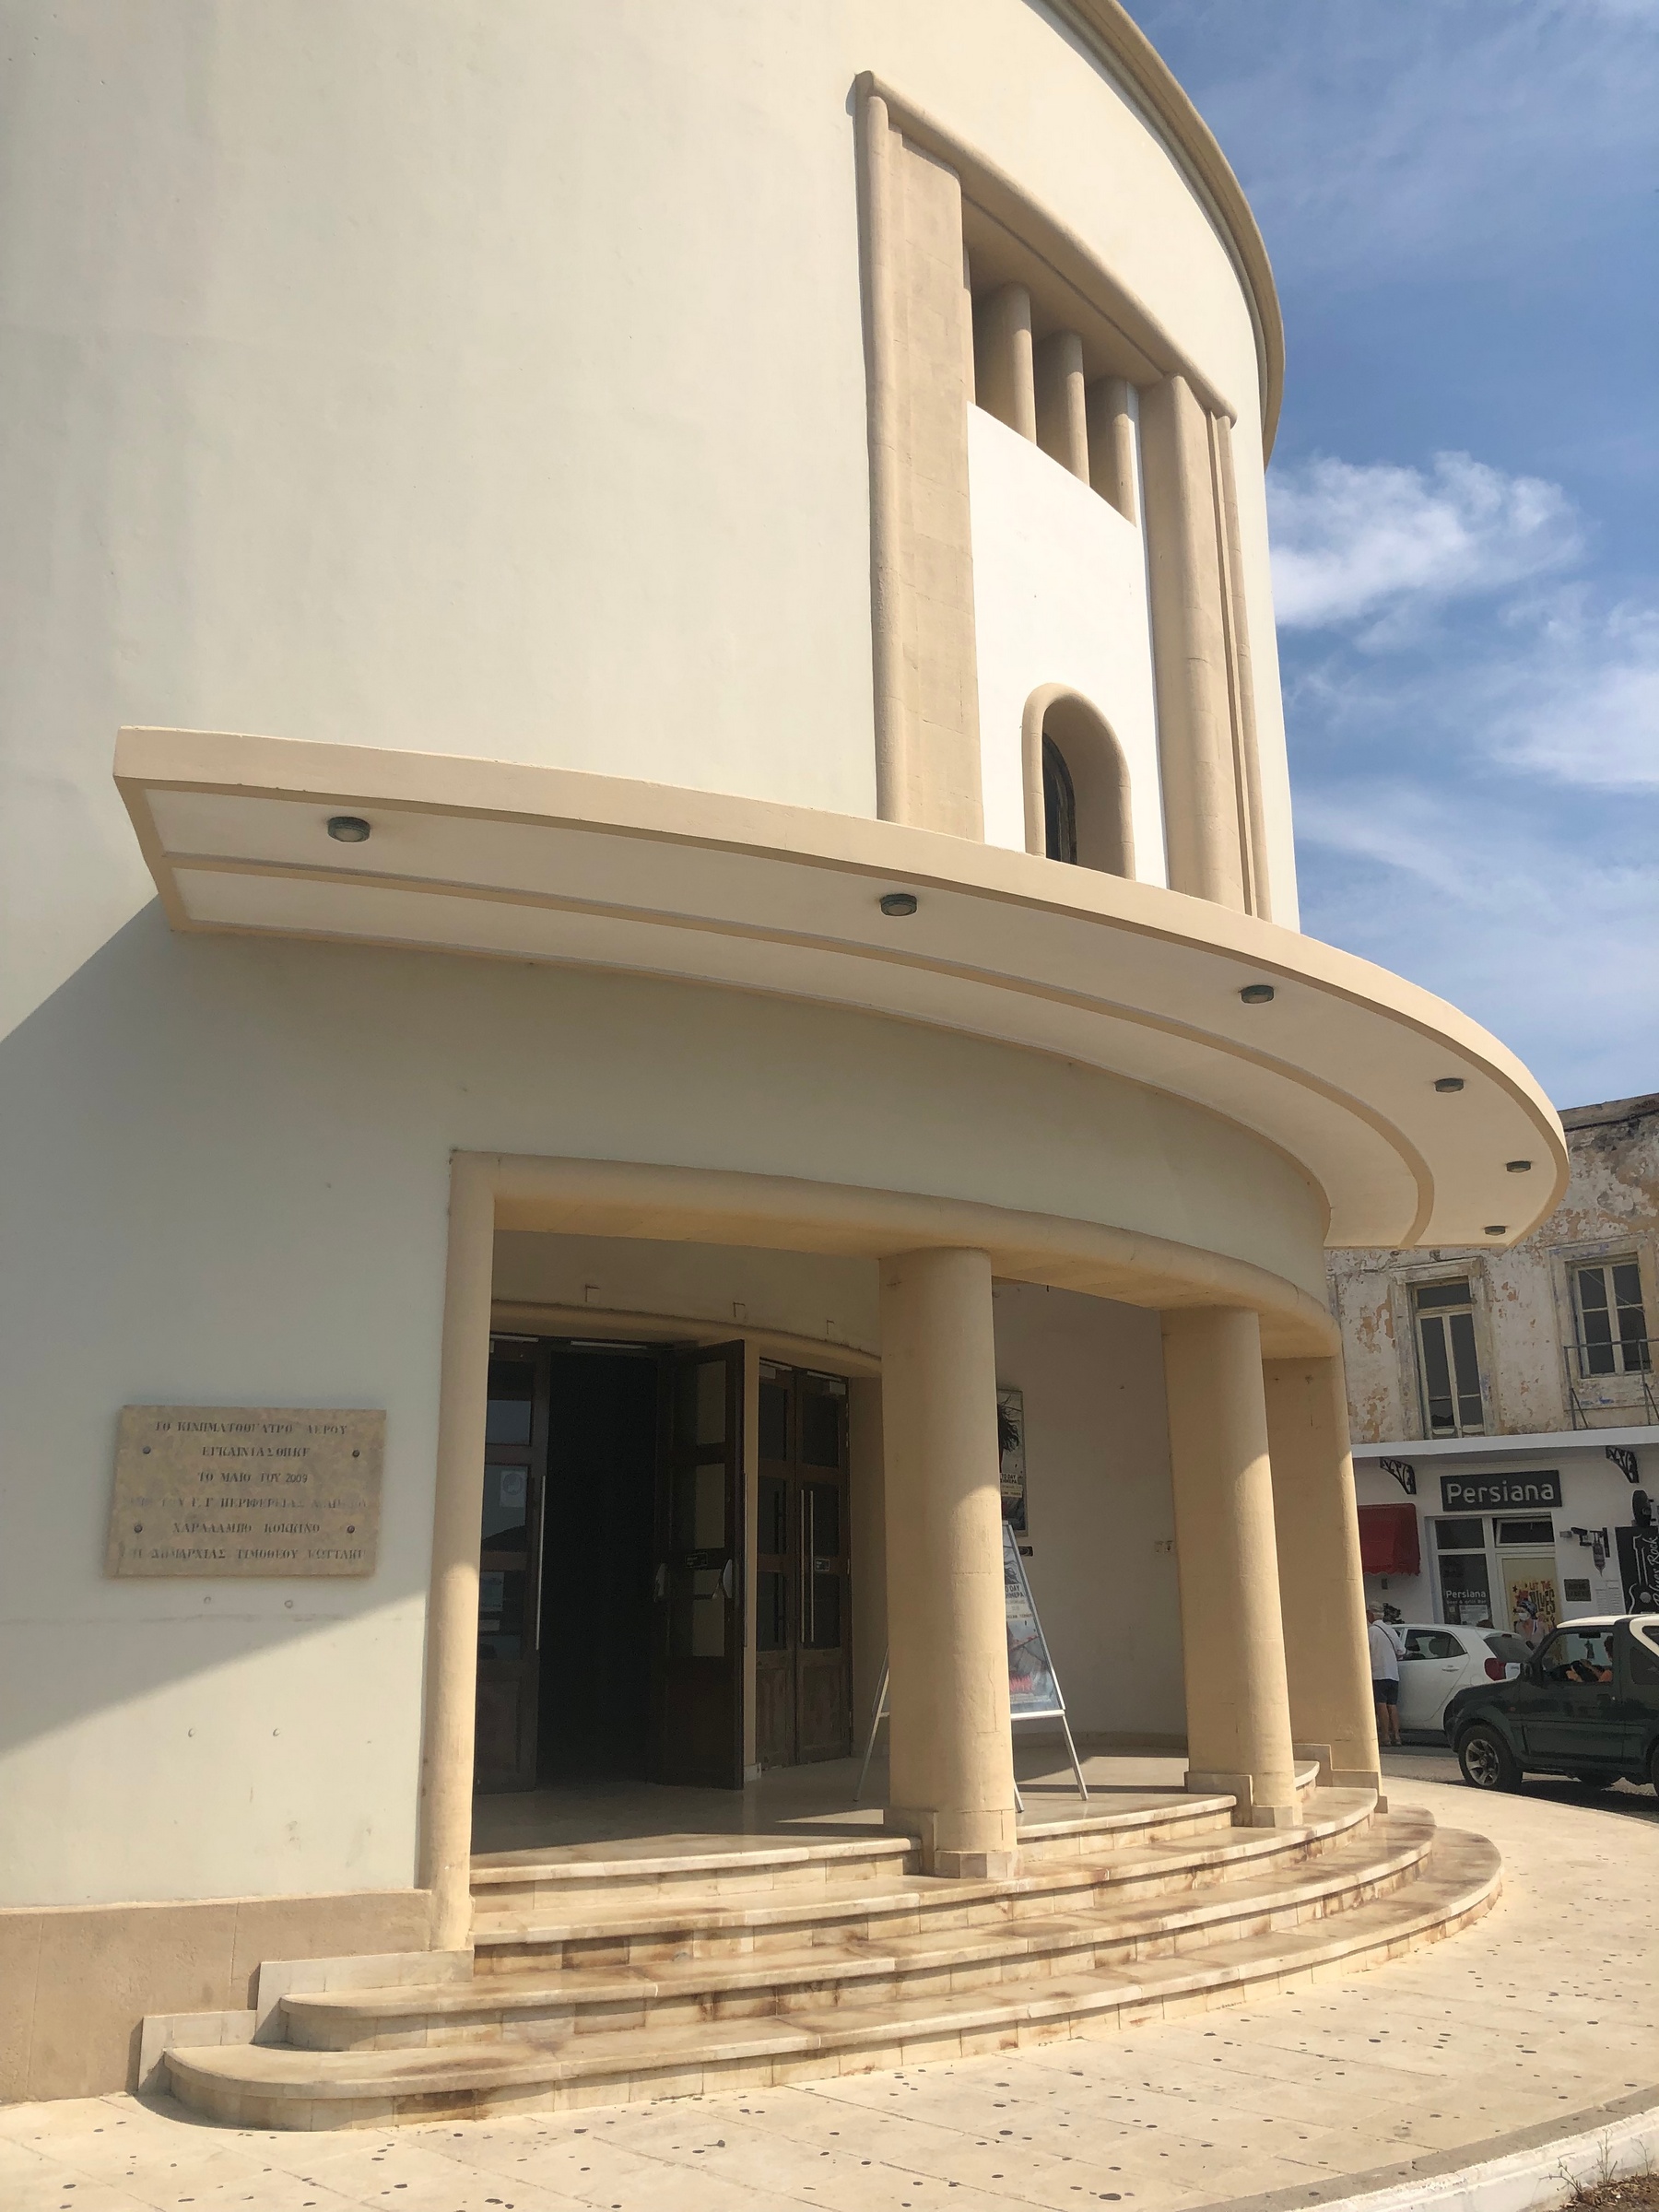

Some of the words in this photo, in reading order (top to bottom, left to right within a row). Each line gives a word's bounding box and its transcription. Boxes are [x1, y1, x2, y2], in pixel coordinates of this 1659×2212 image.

[285, 1473, 308, 1484] 2009
[1446, 1479, 1555, 1504] Persiana
[1446, 1589, 1487, 1598] Persiana
